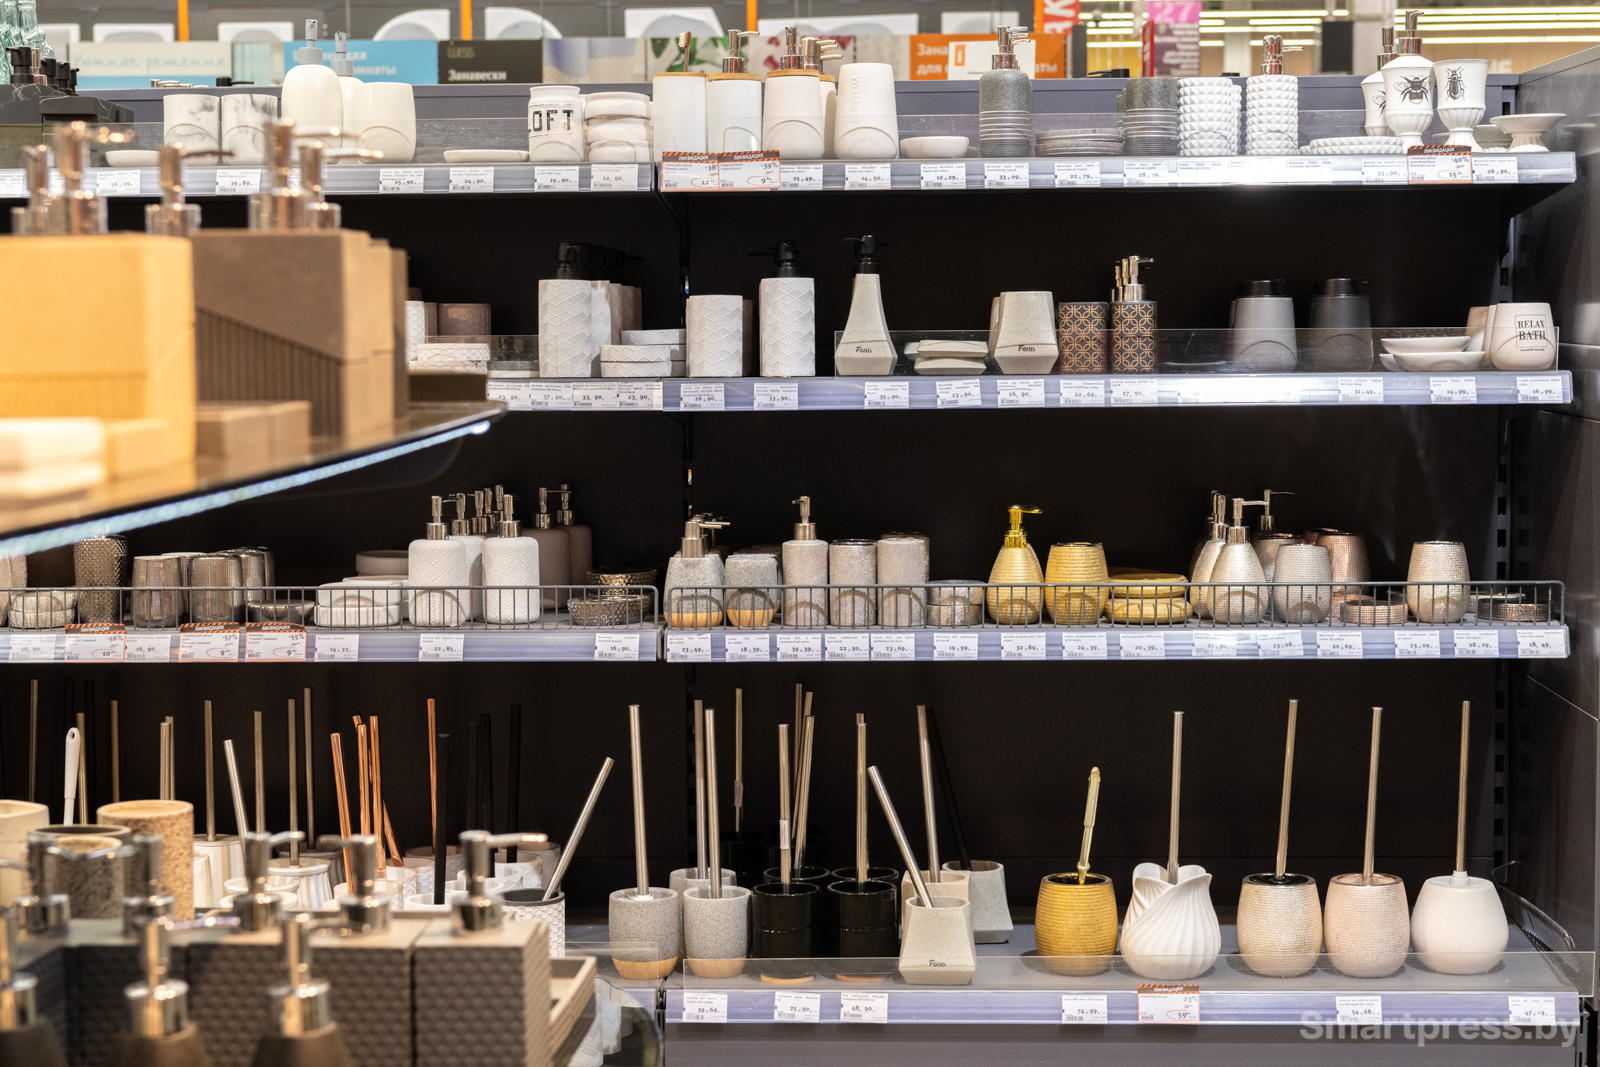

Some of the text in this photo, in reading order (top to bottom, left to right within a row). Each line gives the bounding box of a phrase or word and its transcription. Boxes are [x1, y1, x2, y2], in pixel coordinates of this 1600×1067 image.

[448, 69, 507, 81] Занавески
[850, 74, 862, 124] WELLNESS
[528, 109, 573, 133] OFT
[733, 153, 764, 161] ЛИКВИДАЦИЯ
[1517, 319, 1546, 329] RELAX
[1518, 330, 1546, 341] BATH
